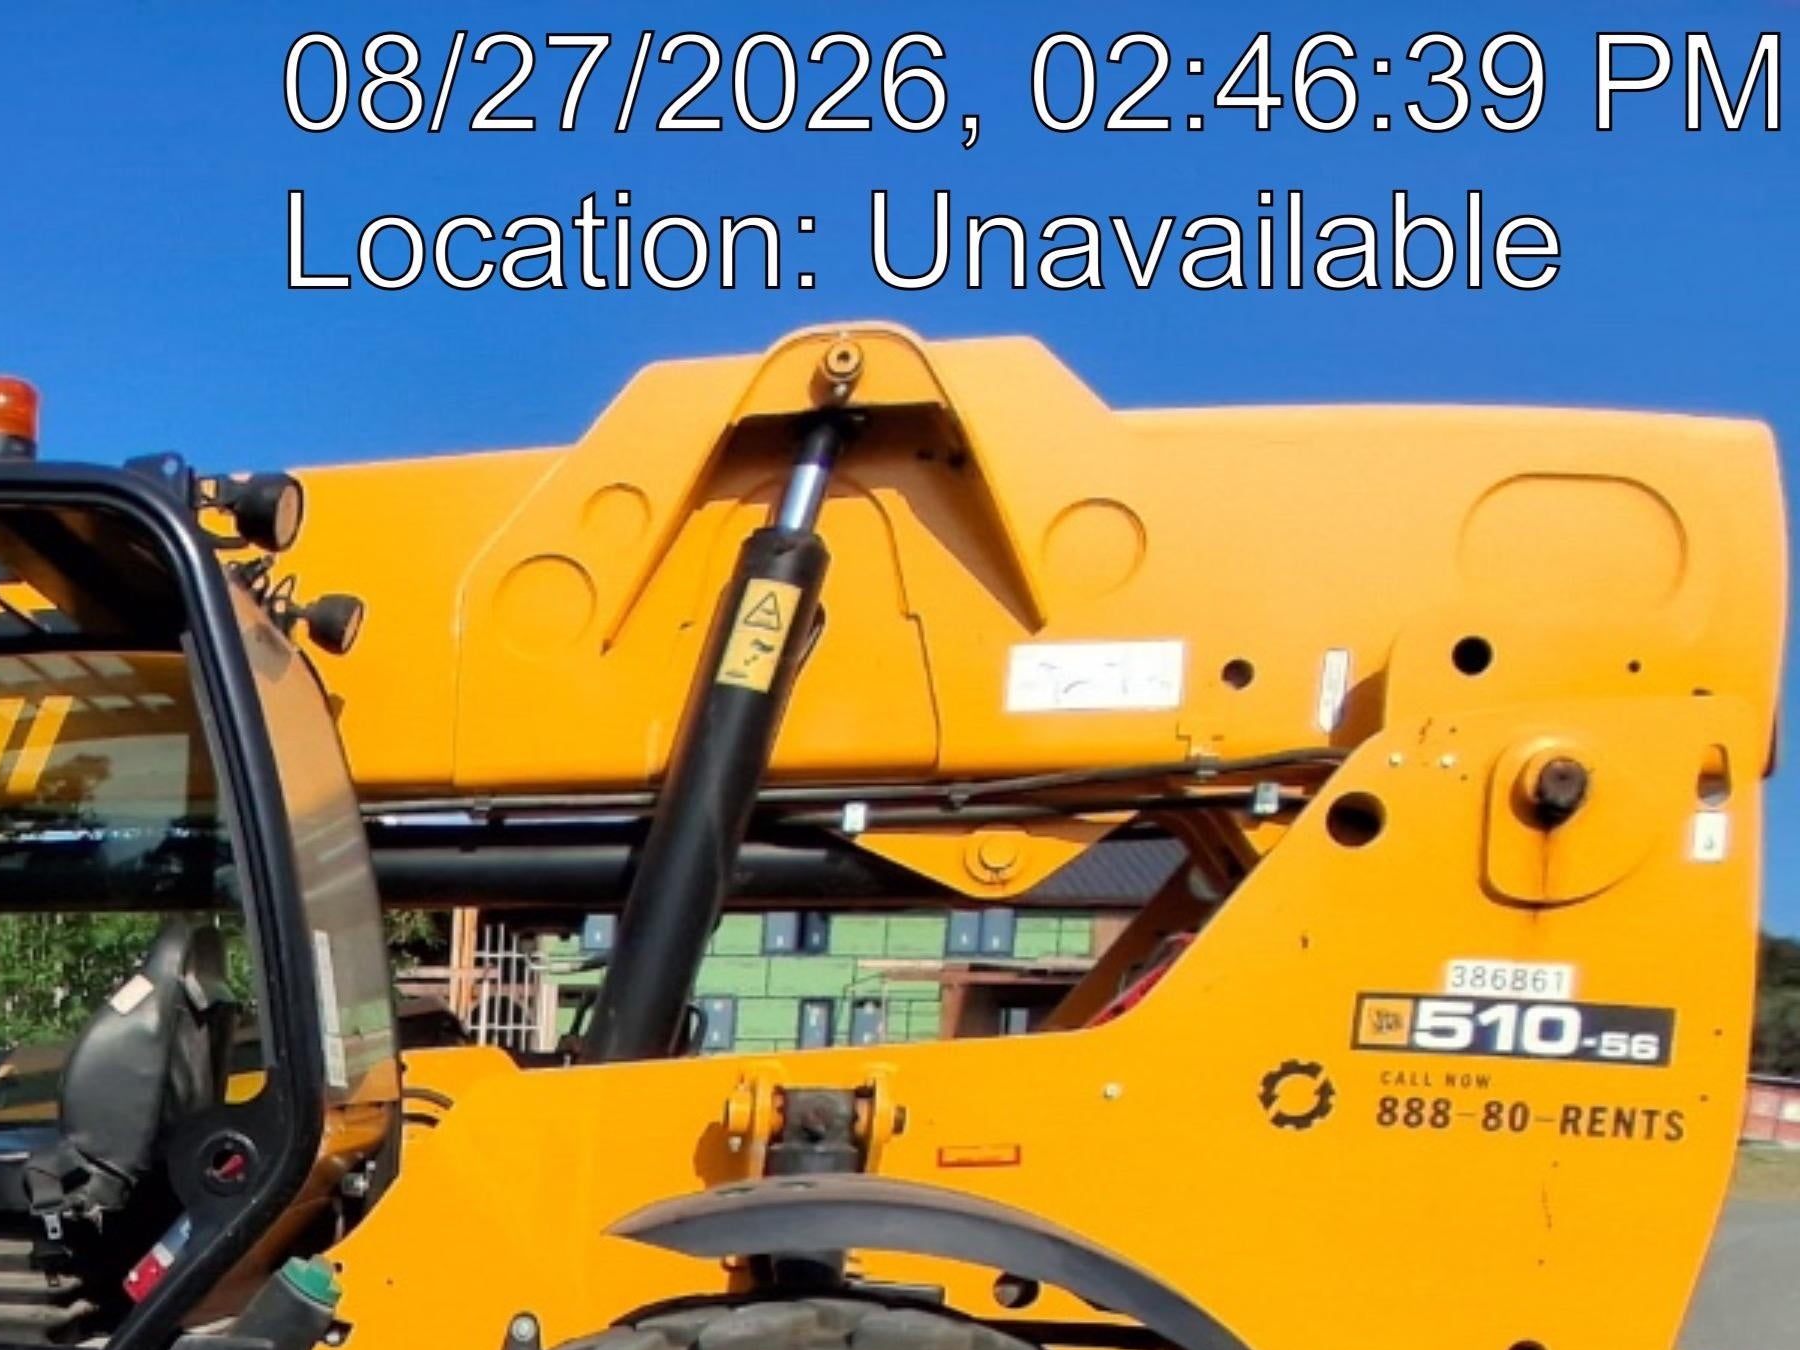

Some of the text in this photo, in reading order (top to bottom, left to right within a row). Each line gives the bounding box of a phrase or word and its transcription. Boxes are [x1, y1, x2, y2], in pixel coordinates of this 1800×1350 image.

[1450, 964, 1566, 993] 386861
[1412, 1000, 1661, 1061] 510-56
[1380, 1070, 1493, 1090] CALL NOW
[1376, 1096, 1686, 1142] 888-80-RENTS
